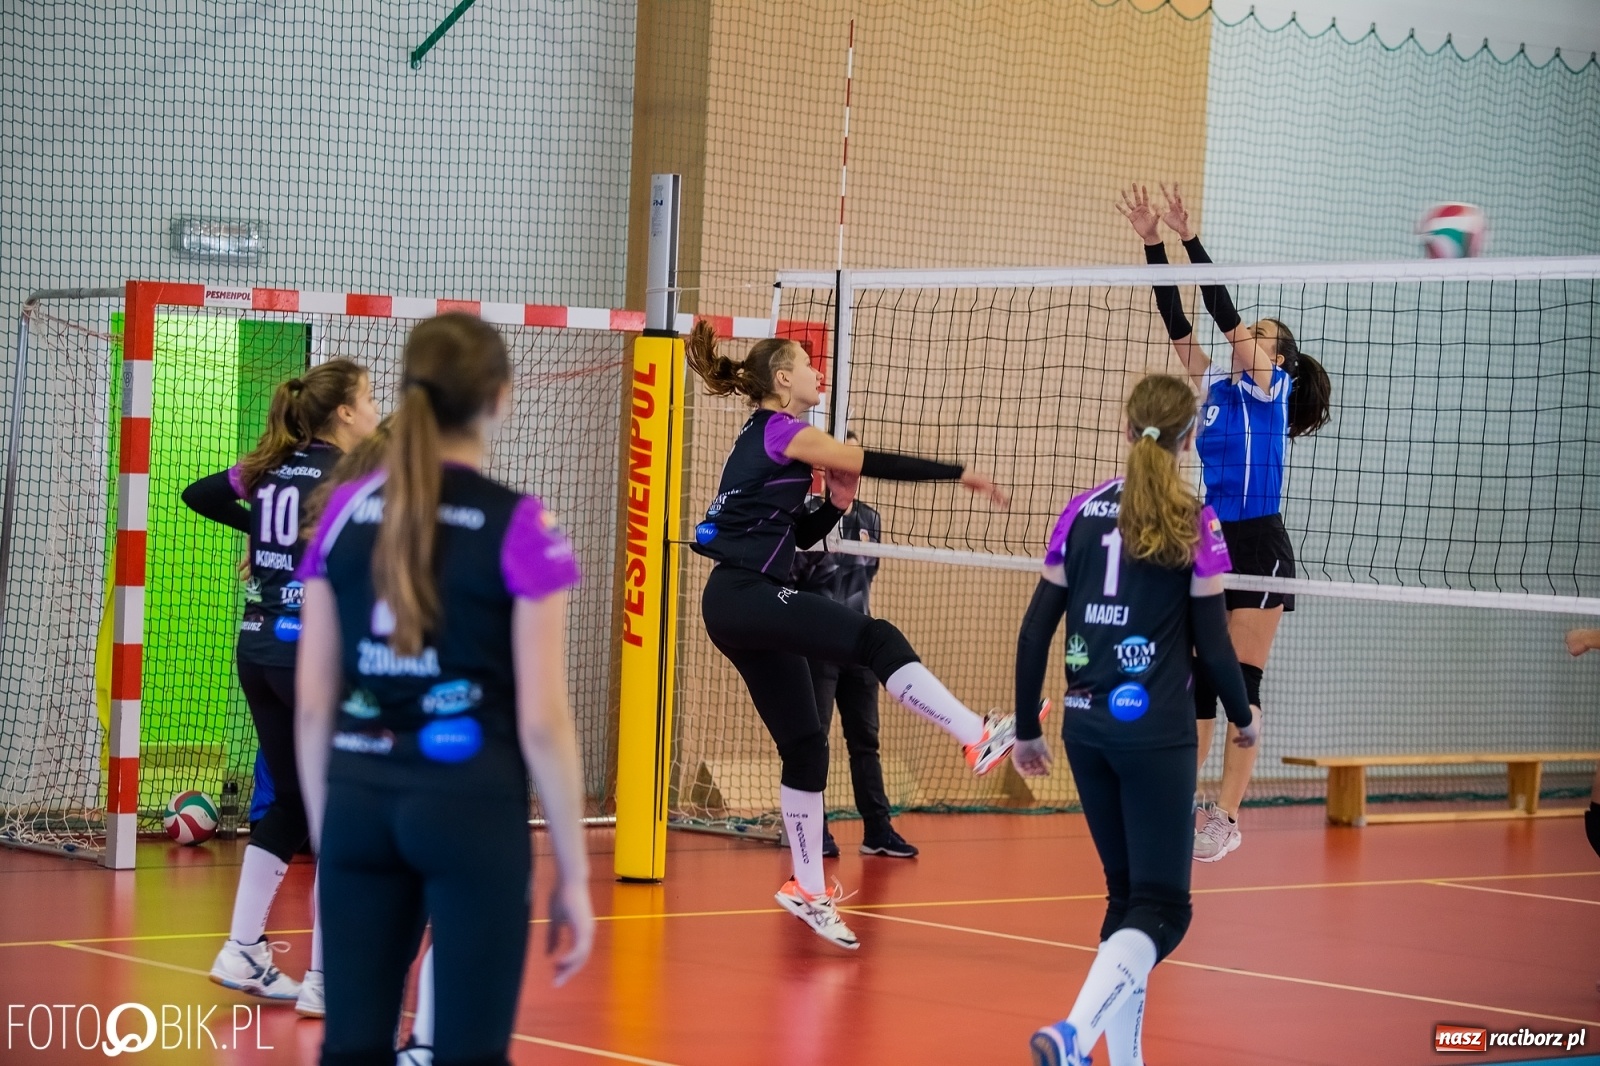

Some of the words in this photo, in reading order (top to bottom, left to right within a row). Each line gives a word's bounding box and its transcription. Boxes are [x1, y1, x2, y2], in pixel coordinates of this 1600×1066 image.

[206, 290, 251, 300] PESMENPOL
[257, 483, 300, 547] 10
[622, 362, 657, 648] PESMENPOL
[1083, 501, 1110, 518] UKS
[255, 550, 294, 572] KORBAL
[1101, 527, 1123, 597] 1
[1084, 603, 1130, 627] MADEJ
[1113, 642, 1156, 660] TOM
[1121, 656, 1151, 668] MED
